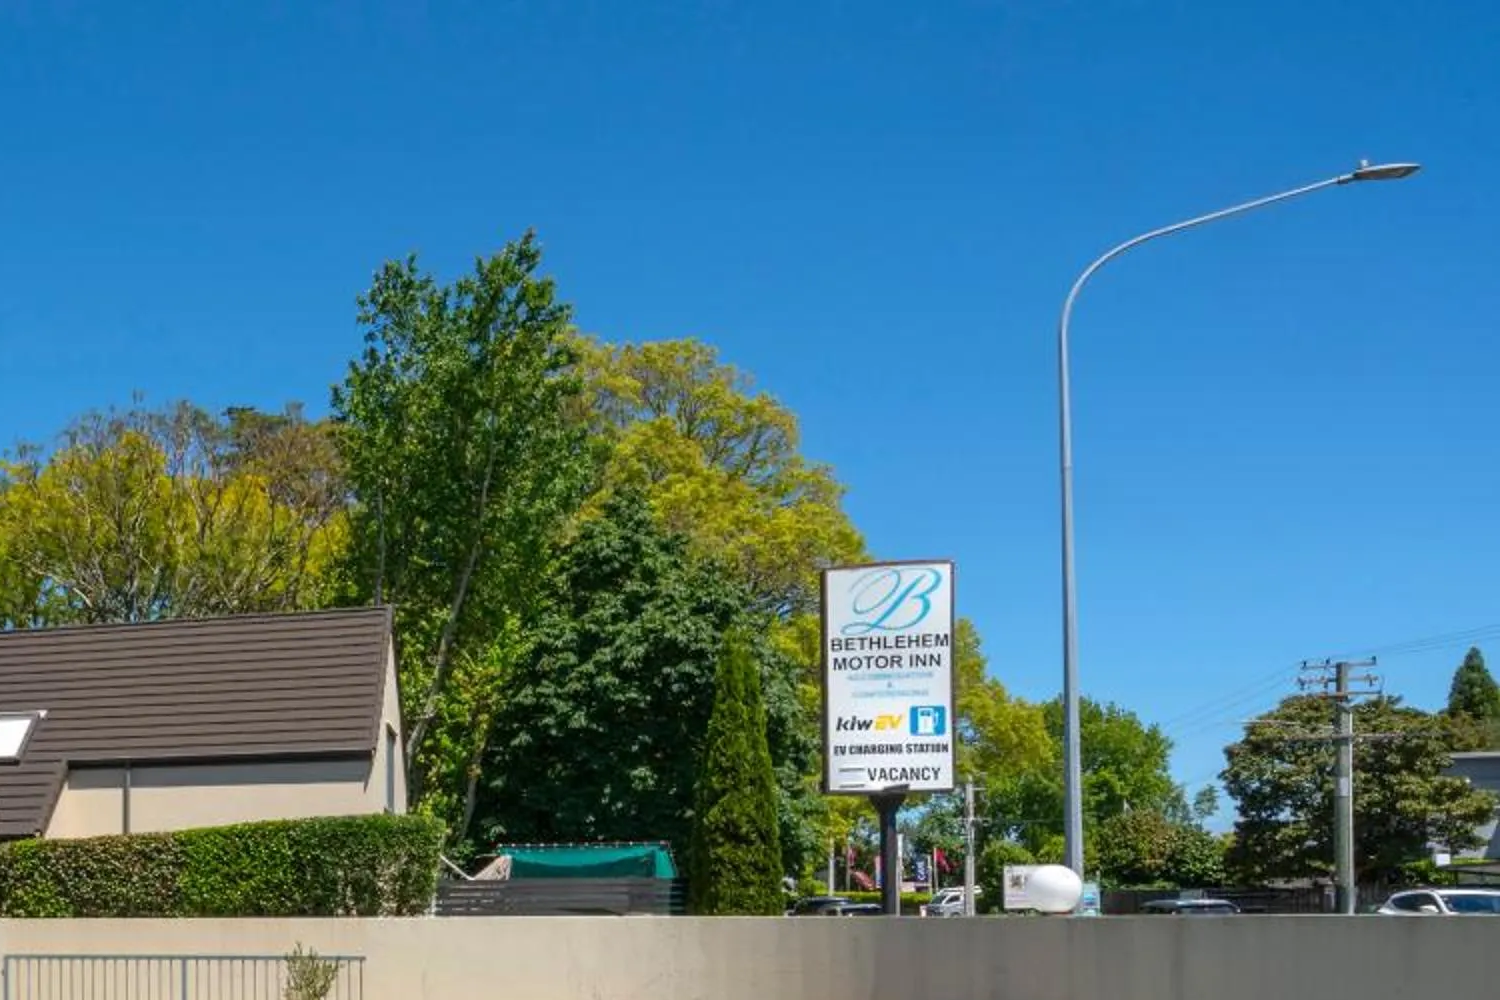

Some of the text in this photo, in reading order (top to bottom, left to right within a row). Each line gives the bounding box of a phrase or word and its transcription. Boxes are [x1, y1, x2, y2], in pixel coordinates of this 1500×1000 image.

[831, 633, 949, 652] BETHLEHEM
[833, 653, 941, 671] MOTOR INN
[834, 743, 949, 756] EV CHARGING STATION
[867, 767, 941, 781] VACANCY
